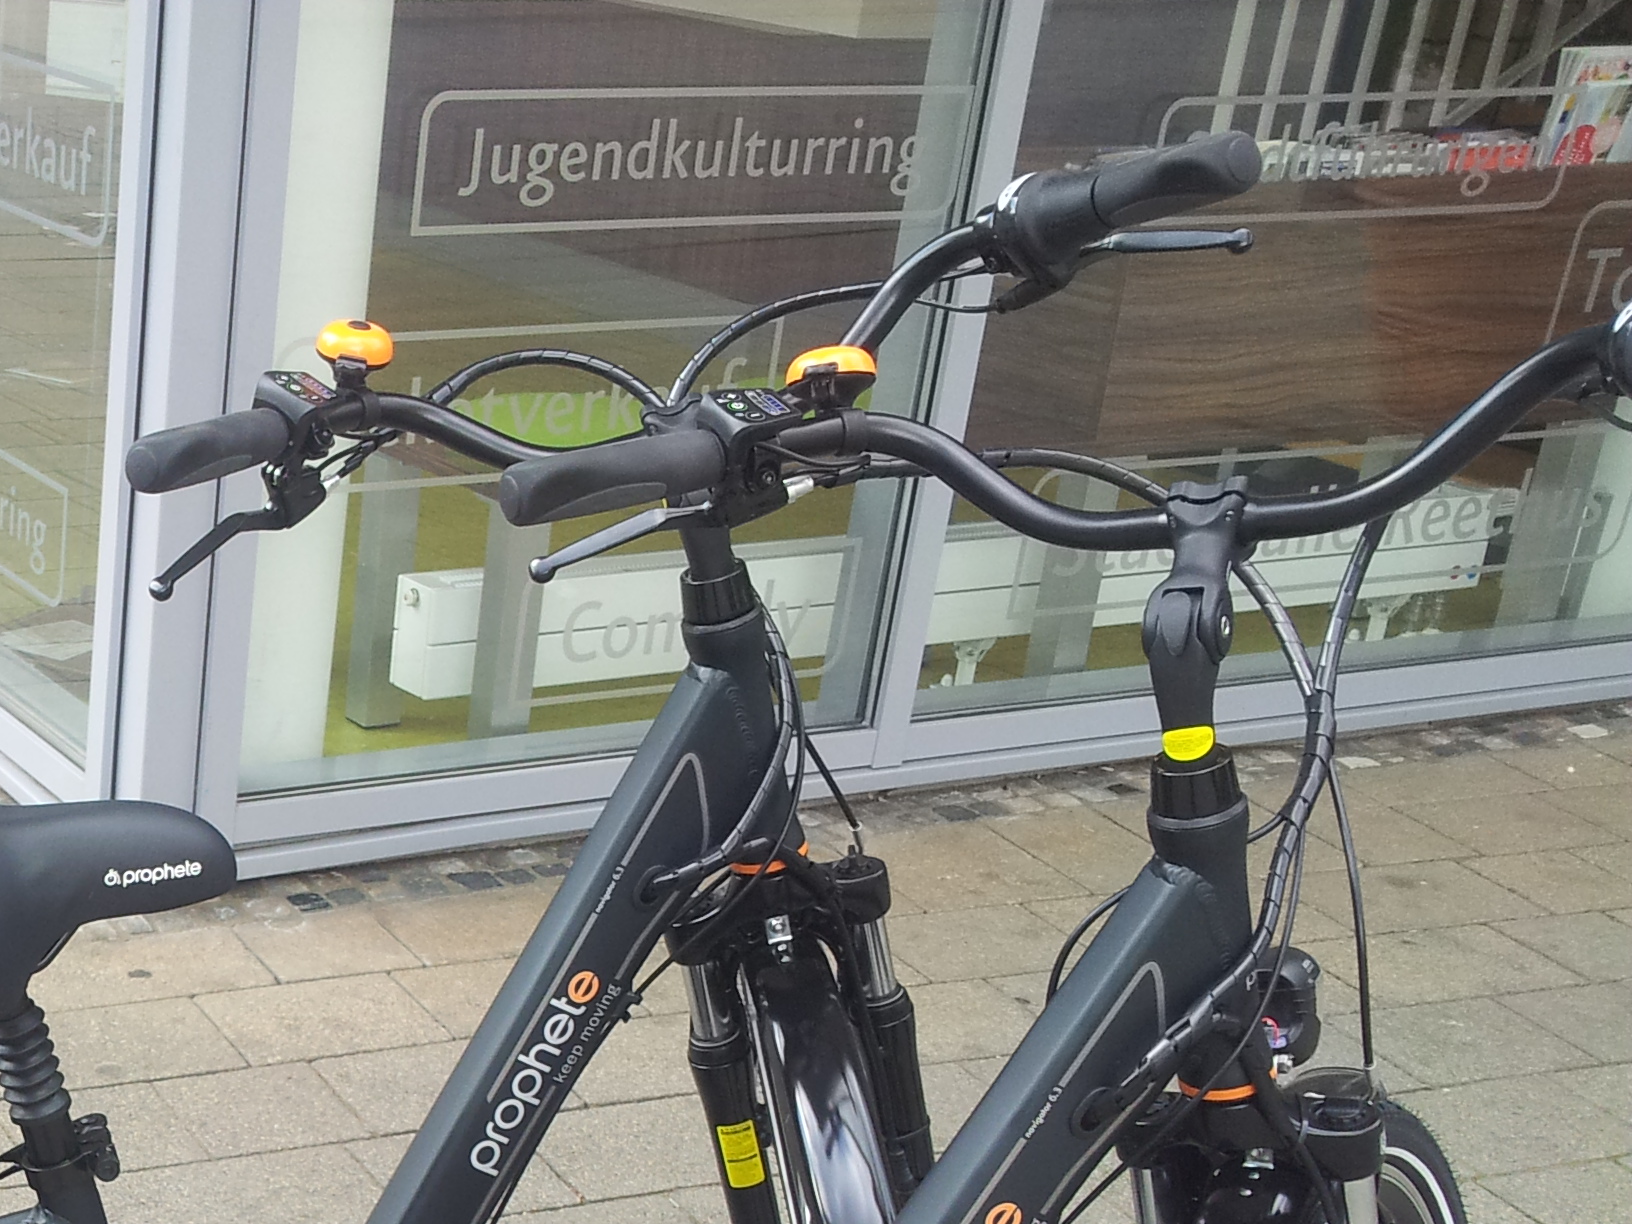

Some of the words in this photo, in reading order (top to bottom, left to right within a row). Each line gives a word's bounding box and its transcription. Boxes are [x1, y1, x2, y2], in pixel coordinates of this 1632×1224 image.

[457, 116, 921, 207] Jugendkulturring
[122, 859, 203, 888] prophete
[470, 970, 601, 1178] prophete
[553, 1044, 584, 1084] keep
[580, 983, 622, 1042] moving
